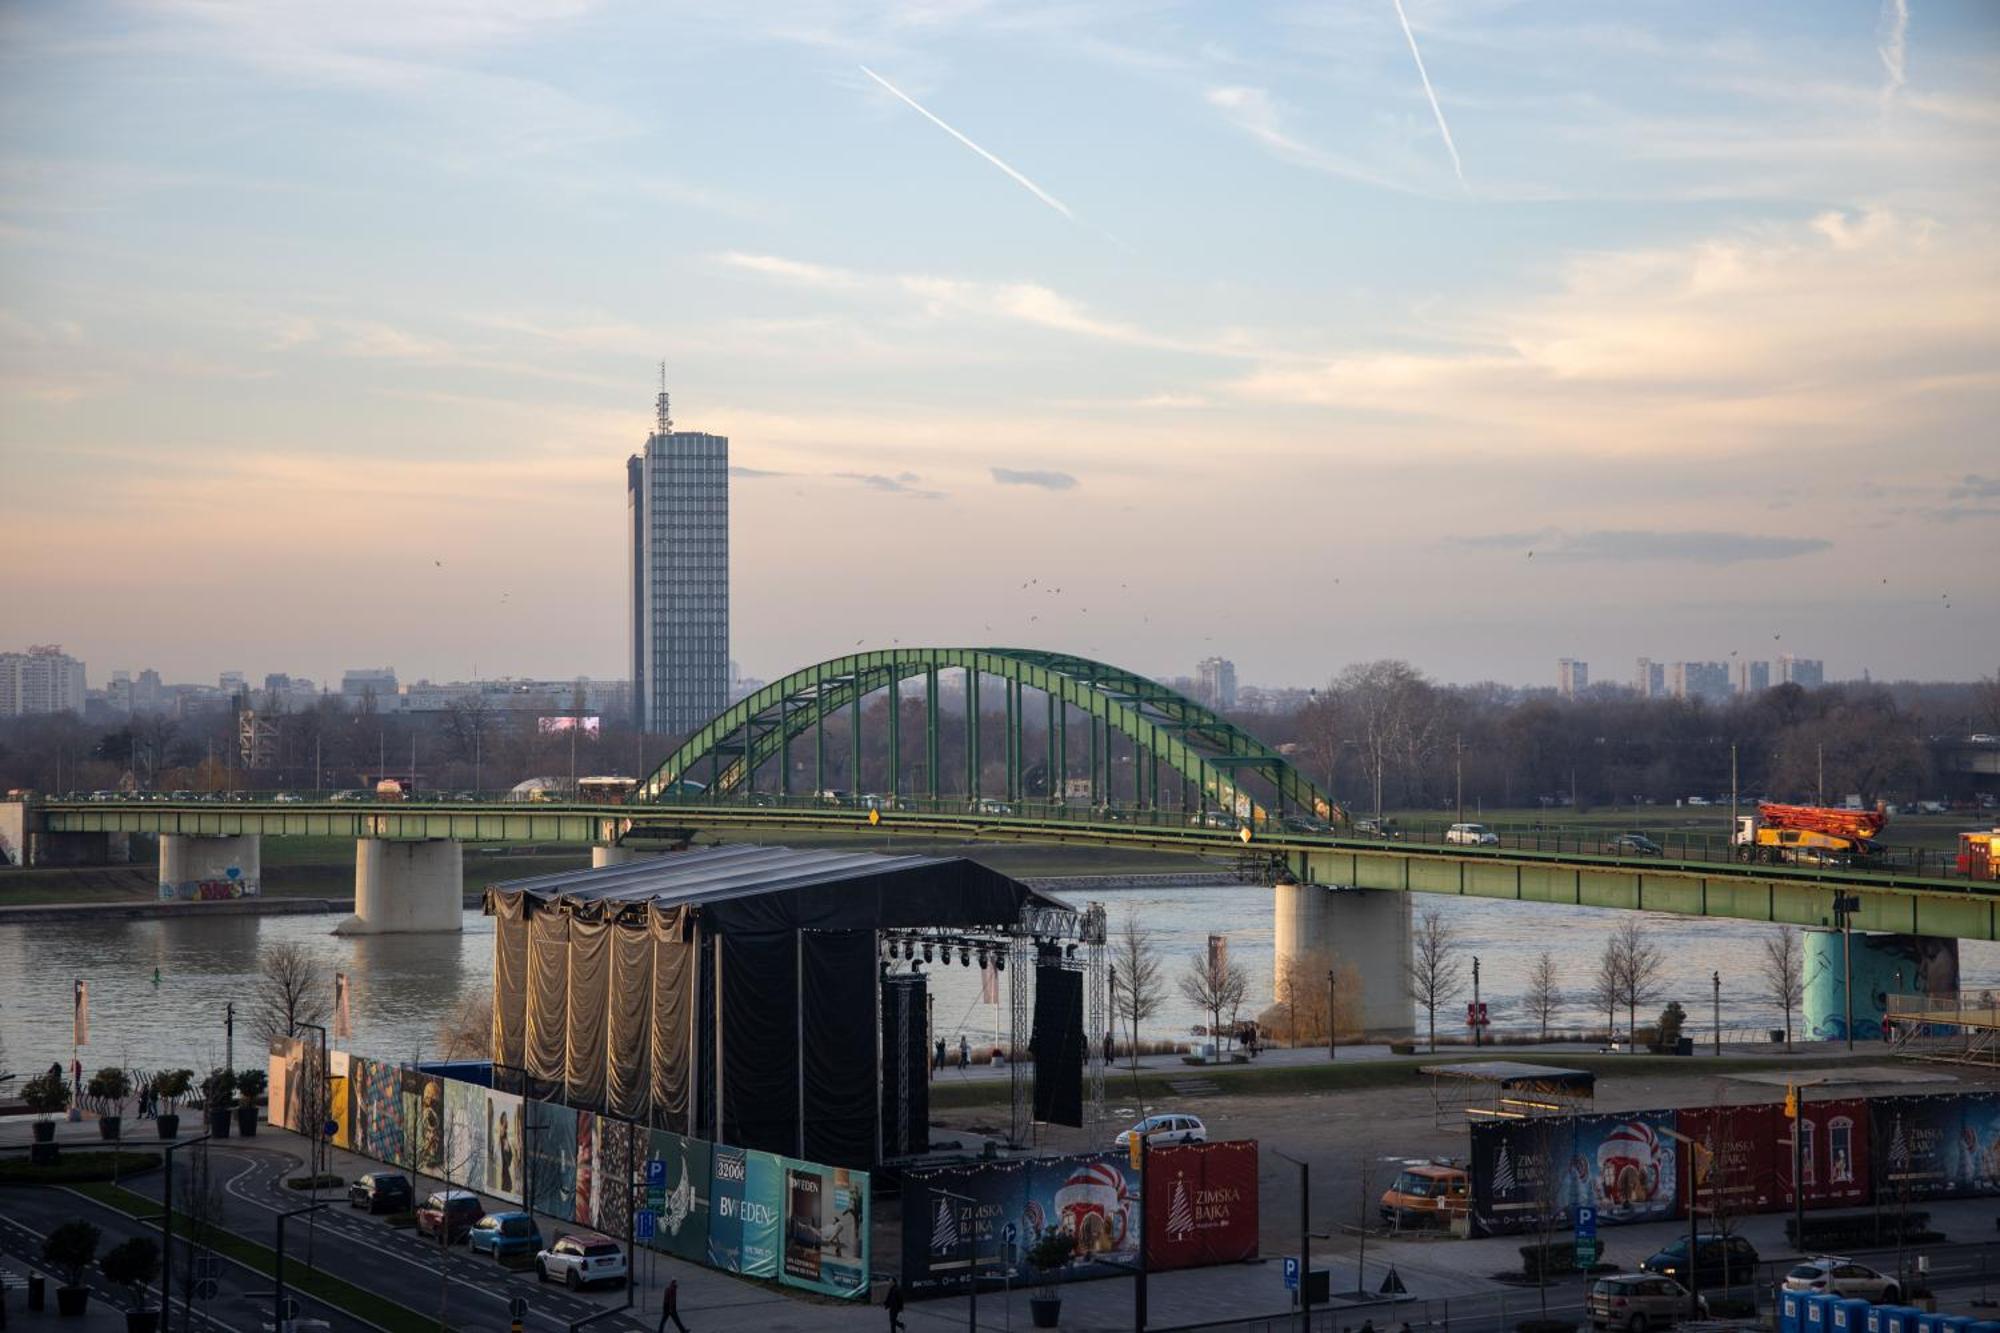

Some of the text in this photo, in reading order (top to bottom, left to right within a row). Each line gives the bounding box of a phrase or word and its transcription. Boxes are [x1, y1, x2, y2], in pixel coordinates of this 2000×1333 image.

[650, 1162, 662, 1178] P
[1195, 1188, 1240, 1204] ZIMSKA
[740, 1201, 770, 1224] EDEN
[1195, 1204, 1230, 1221] BAJKA
[1579, 1208, 1592, 1225] P
[1286, 1259, 1296, 1276] P
